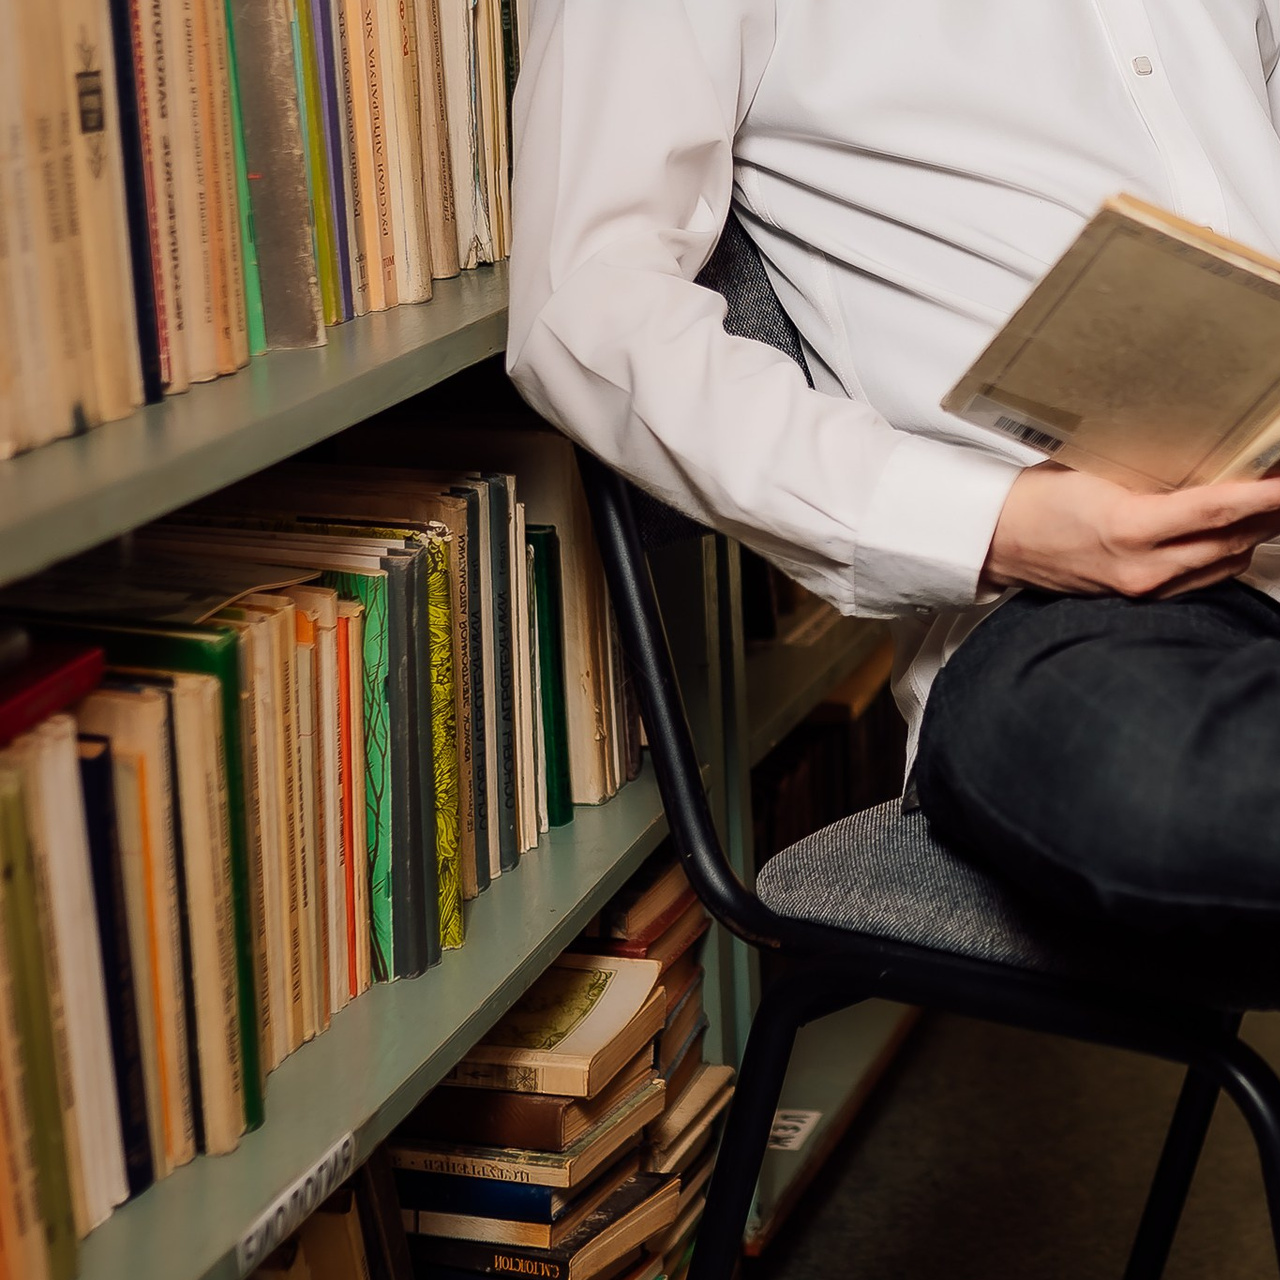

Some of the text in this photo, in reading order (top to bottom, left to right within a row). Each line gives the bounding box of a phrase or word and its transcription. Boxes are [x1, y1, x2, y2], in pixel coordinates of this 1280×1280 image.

[342, 47, 355, 144] литература
[368, 47, 384, 157] ЛИТЕРАТУРА
[350, 151, 361, 219] Русская
[378, 163, 389, 237] РУССКАЯ
[457, 534, 467, 615] АВТОМАТИКИ
[459, 620, 471, 709] ЭЛЕКТРОННОЙ
[497, 591, 512, 723] АГРОТЕХНИКИ
[476, 752, 488, 831] ОСНОВЫ
[502, 730, 514, 810] ОСНОВЫ
[244, 1138, 352, 1262] БИОЛОГИЯ
